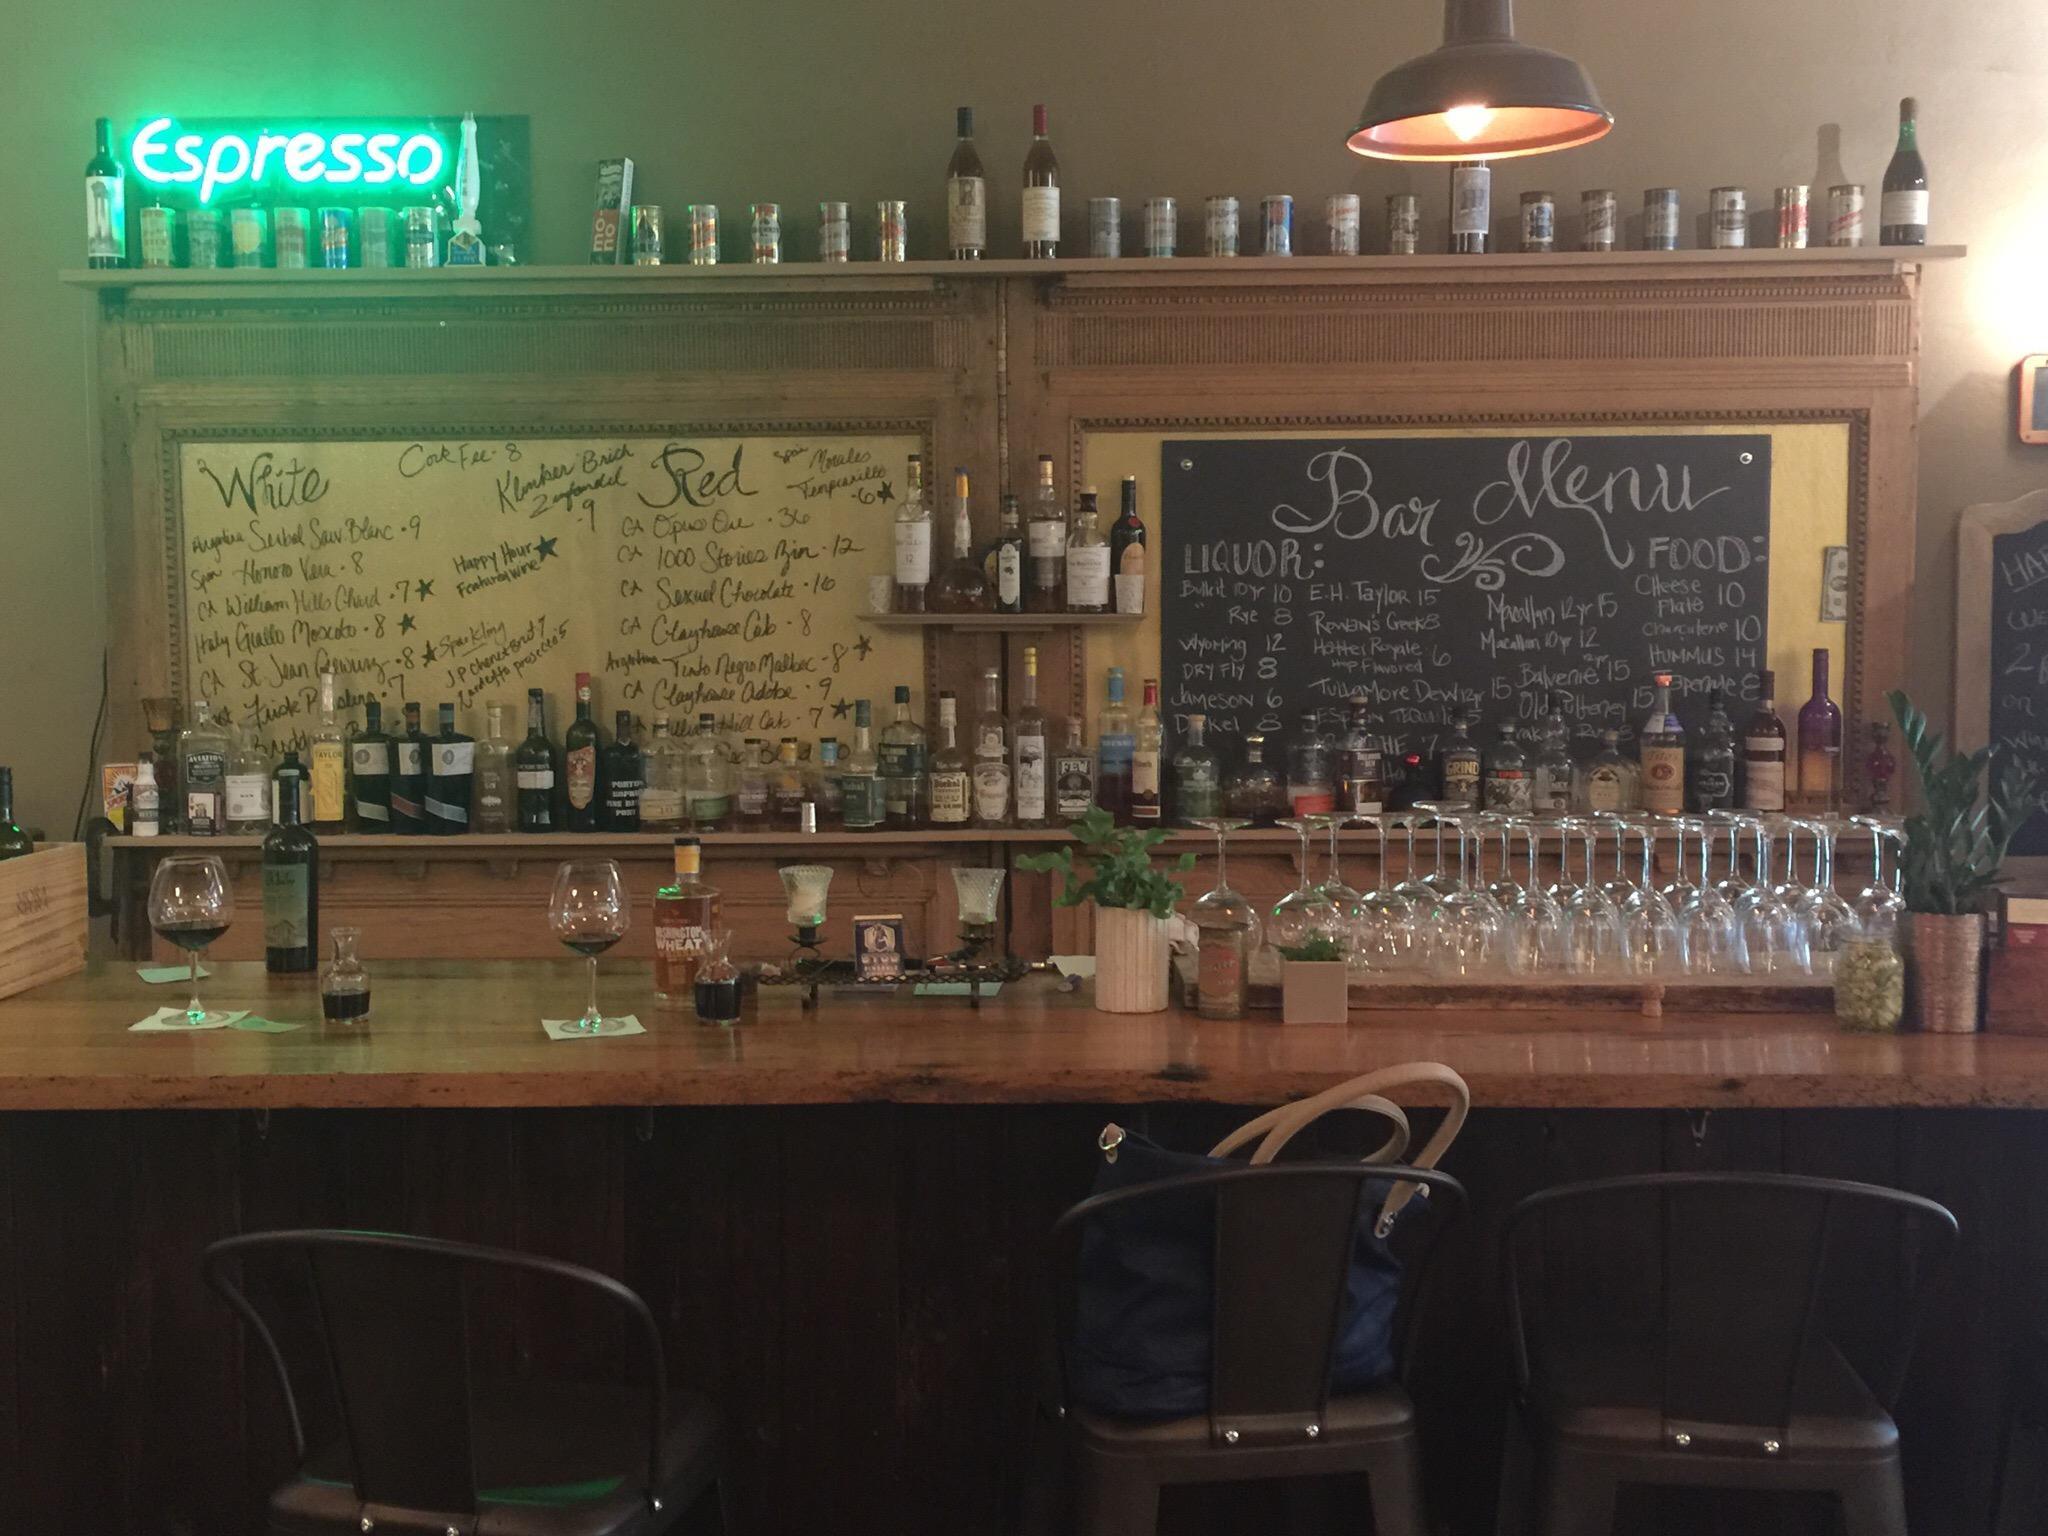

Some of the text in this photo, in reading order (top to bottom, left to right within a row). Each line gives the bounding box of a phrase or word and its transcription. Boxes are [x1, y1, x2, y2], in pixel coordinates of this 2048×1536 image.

[132, 118, 442, 203] Espresso
[399, 444, 456, 477] Cork
[505, 443, 522, 462] 8
[582, 443, 634, 474] Brick
[197, 452, 330, 516] White
[637, 442, 758, 508] Red
[1272, 438, 1732, 568] Bar Menu
[345, 515, 394, 544] Blanc
[652, 513, 708, 544] Opus
[711, 509, 754, 533] One
[351, 550, 363, 574] 8
[453, 540, 532, 574] Happy Hour
[656, 547, 696, 570] 1000
[700, 540, 767, 574] Stories
[832, 534, 864, 558] 12
[1184, 535, 1768, 580] LIQUOR: FOOD:
[226, 593, 291, 617] William
[335, 583, 382, 612] Chard
[656, 576, 716, 611] Sexual
[720, 575, 796, 609] Chocolate
[1180, 578, 1228, 598] Bulleit
[1274, 583, 1293, 604] 10
[1418, 588, 1441, 606] 15
[1598, 592, 1618, 618] 15
[1718, 581, 1746, 608] 10
[742, 608, 777, 643] Cab
[800, 608, 812, 637] 8
[1228, 605, 1293, 625] Rye 8
[1423, 613, 1441, 630] 8
[1735, 615, 1762, 642] 10
[292, 617, 358, 647] Moscato
[374, 613, 386, 639] 8
[1580, 626, 1600, 648] 12
[1179, 632, 1287, 662] Wyoming 12
[1361, 658, 1424, 675] Flavored
[1432, 644, 1451, 666] 6
[1735, 647, 1757, 668] 14
[268, 653, 309, 689] Jean
[400, 646, 415, 669] 8
[758, 652, 817, 680] Malbec
[1257, 656, 1278, 680] 8
[1515, 663, 1600, 690] Balvenie
[1608, 660, 1631, 682] 15
[819, 676, 833, 700] 9
[1266, 688, 1283, 708] 6
[1491, 677, 1512, 699] 15
[1519, 691, 1549, 720] Old
[1632, 685, 1654, 709] 15
[758, 709, 792, 730] Cab
[809, 705, 824, 728] 7
[1174, 713, 1282, 734] Dkel 8
[1061, 760, 1089, 774] FEW
[1446, 761, 1479, 776] GRIND
[656, 938, 703, 952] WHEAT
